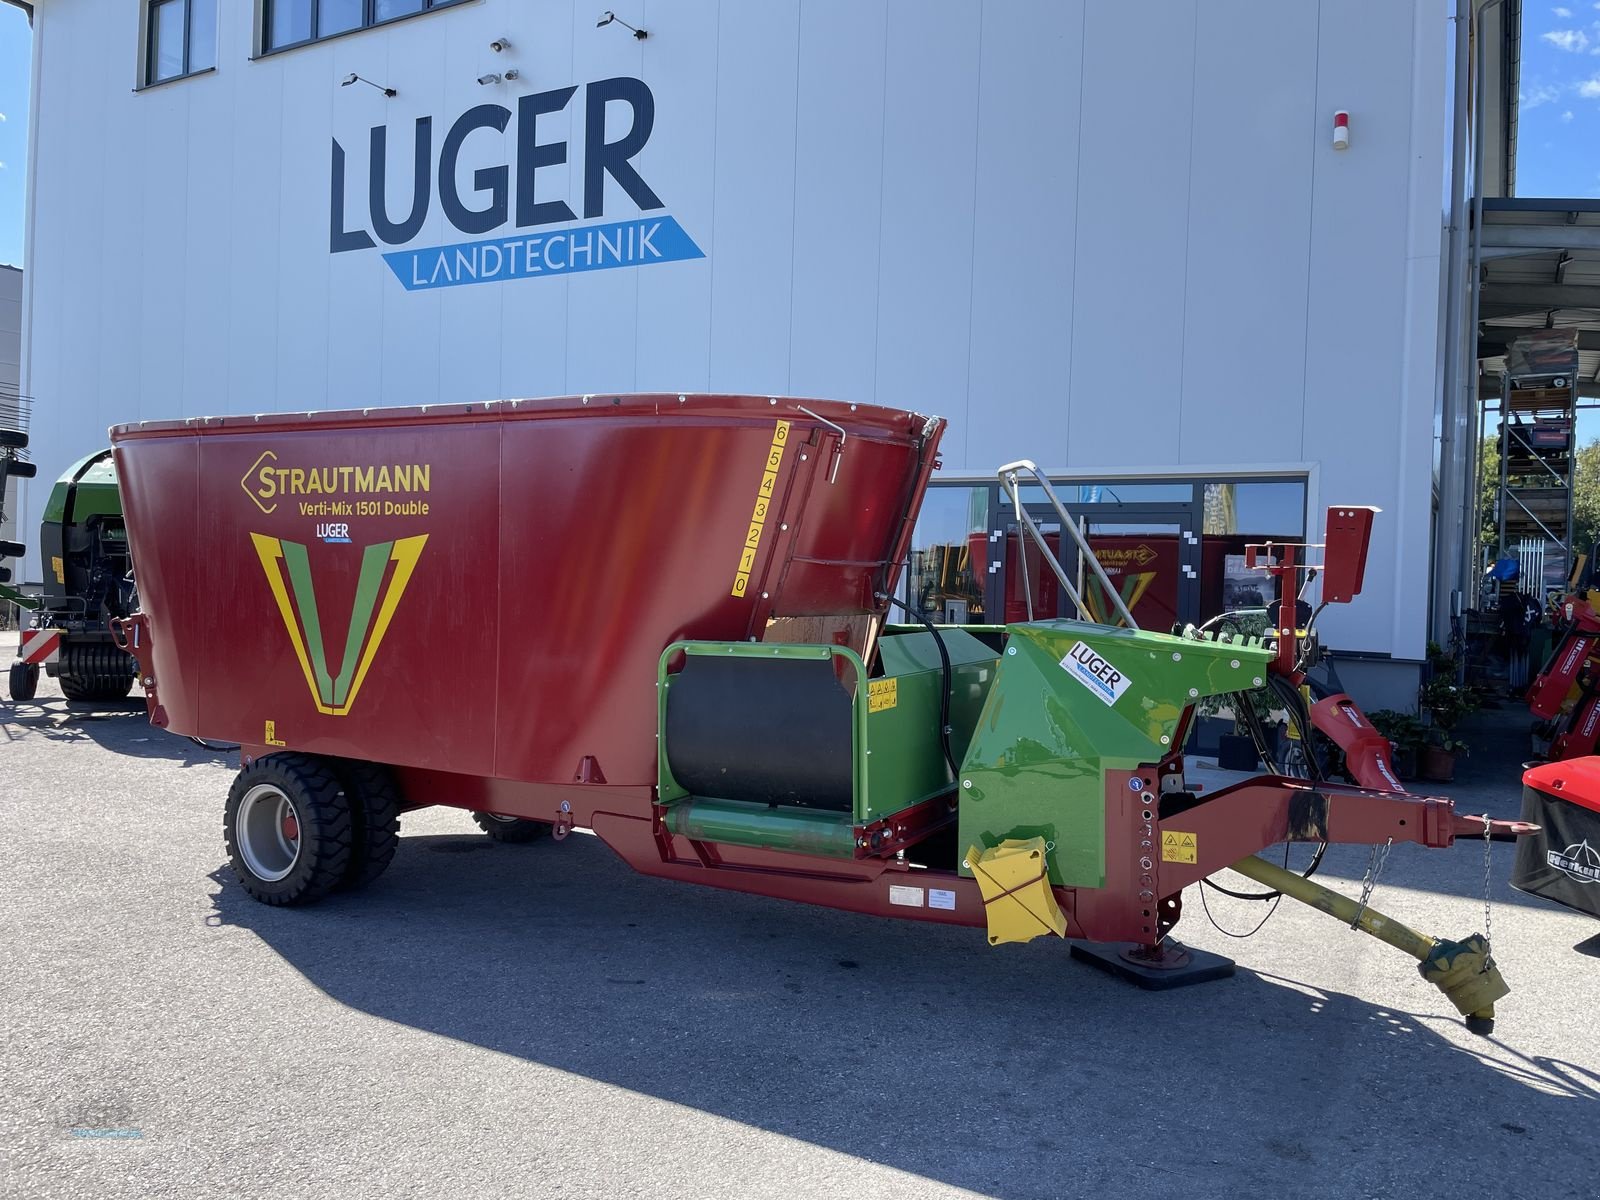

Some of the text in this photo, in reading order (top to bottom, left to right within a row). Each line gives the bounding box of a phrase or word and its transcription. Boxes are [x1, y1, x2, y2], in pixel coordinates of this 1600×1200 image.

[330, 76, 666, 254] LUGER
[412, 222, 663, 286] LANDTECHNIK
[776, 427, 786, 440] 6
[769, 452, 779, 466] 5
[258, 464, 430, 498] STRAUTMANN
[762, 478, 772, 491] 4
[299, 500, 430, 516] Verti-Mix 1501 Double
[756, 503, 766, 517] 3
[316, 523, 349, 538] LUGER
[749, 529, 759, 543] 2
[735, 578, 745, 591] 0
[1070, 643, 1121, 690] LUGER
